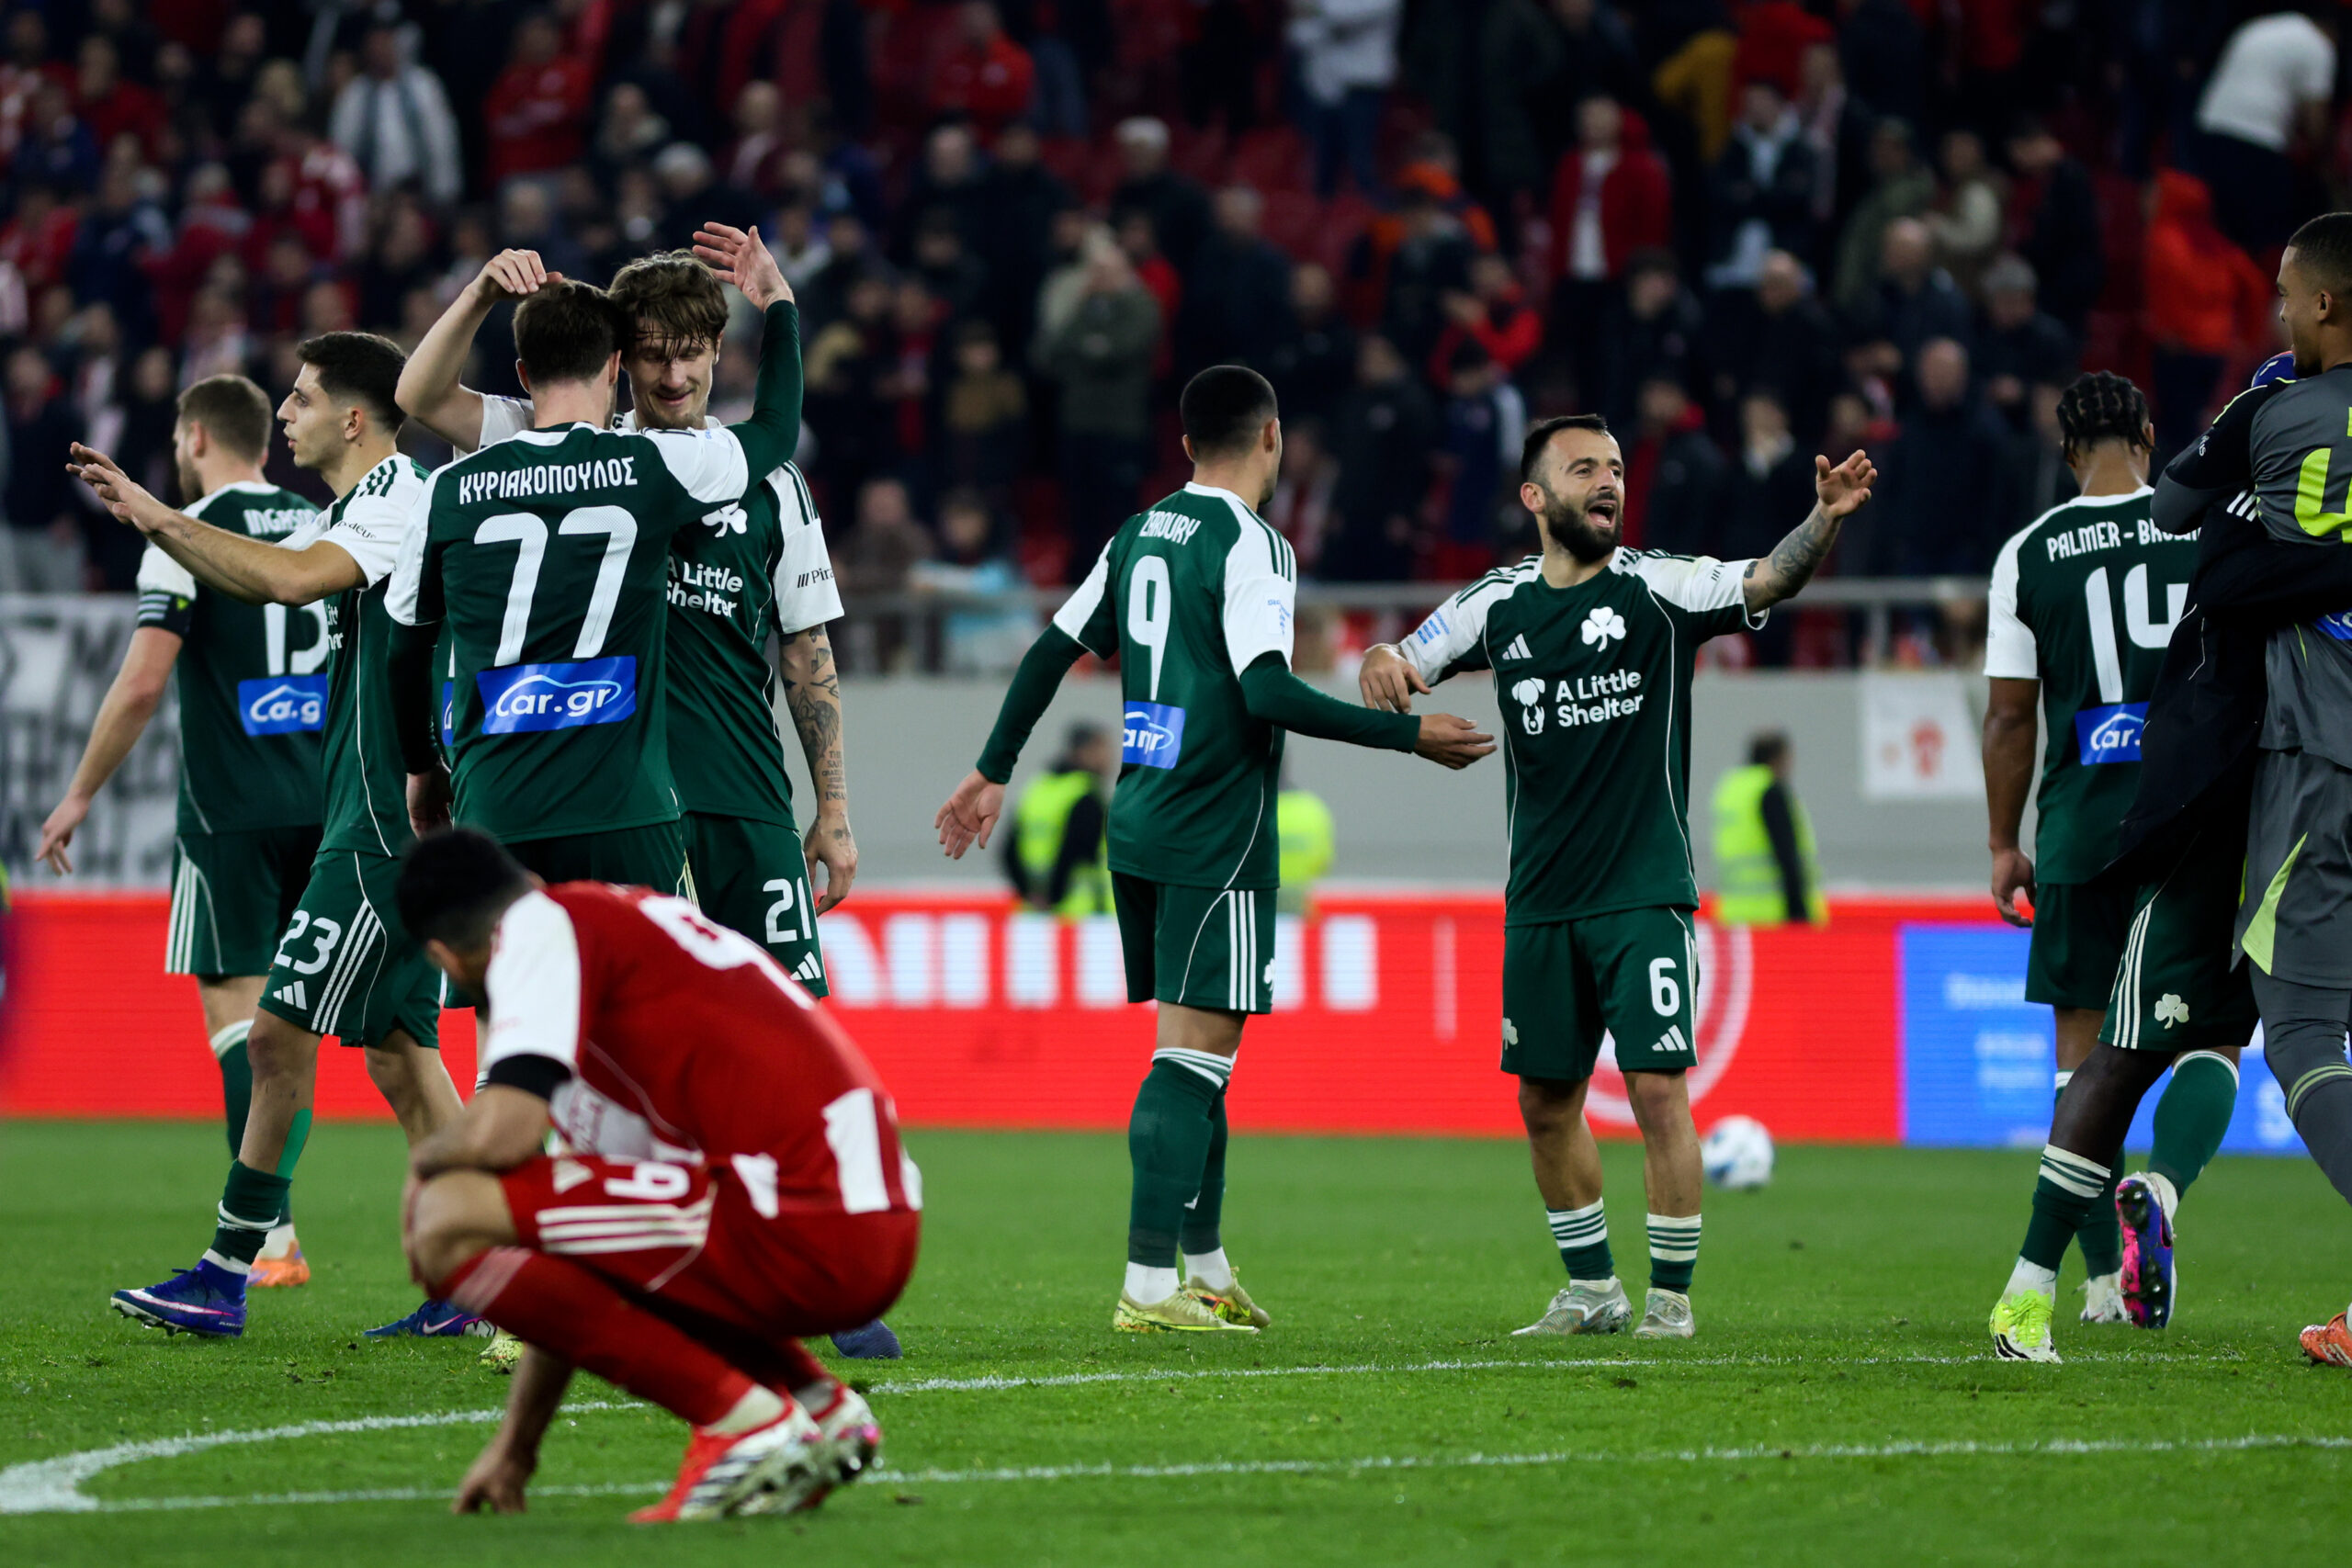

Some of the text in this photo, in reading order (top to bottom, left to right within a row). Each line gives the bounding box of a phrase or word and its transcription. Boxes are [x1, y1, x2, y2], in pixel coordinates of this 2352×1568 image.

[459, 457, 638, 505] ΚΥΡΙΑΚΟΠΟΥΛΟΣ
[474, 504, 639, 667] 77
[683, 561, 744, 593] Little
[1127, 555, 1171, 701] 9
[2085, 563, 2190, 705] 14
[495, 678, 622, 717] car.gr
[1555, 668, 1642, 703] A Little
[1557, 694, 1644, 728] Shelter
[763, 876, 812, 944] 21
[274, 908, 342, 976] 23
[1648, 956, 1680, 1017] 6
